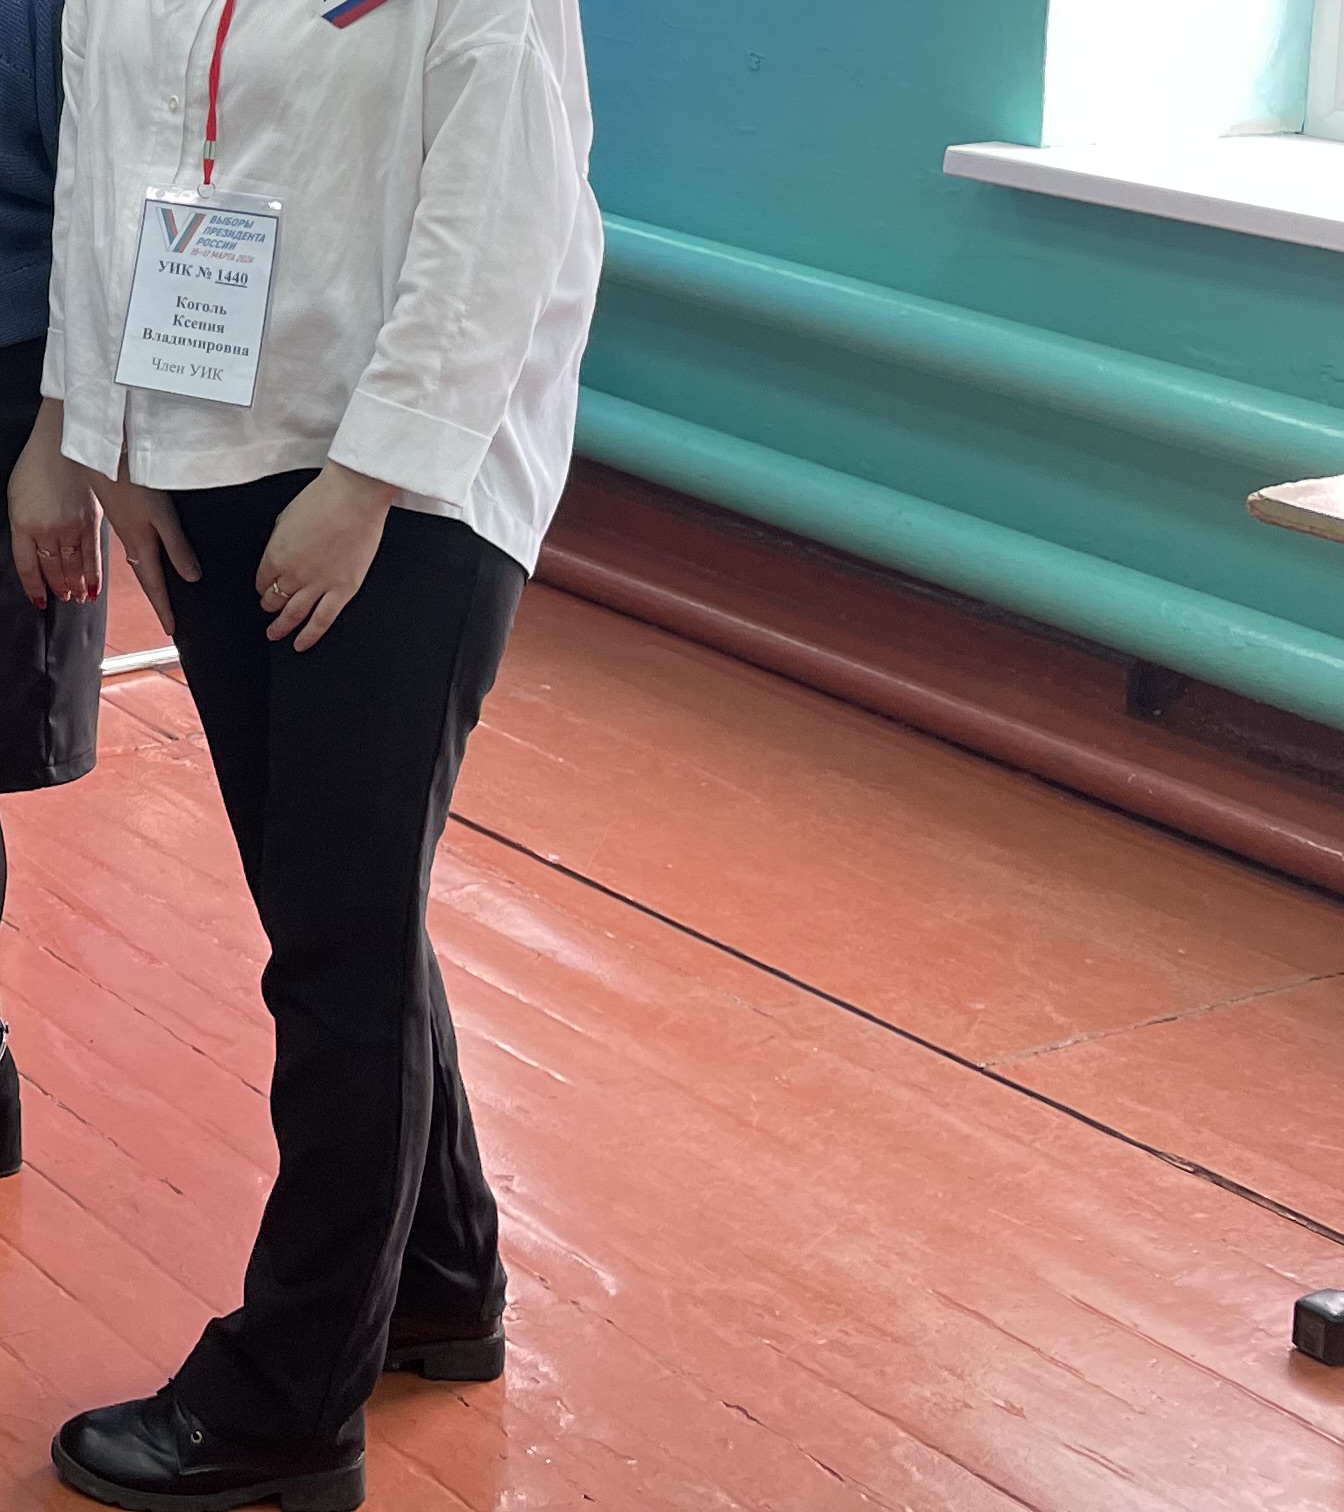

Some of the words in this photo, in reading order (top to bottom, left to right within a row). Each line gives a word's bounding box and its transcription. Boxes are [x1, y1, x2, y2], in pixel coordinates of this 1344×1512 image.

[209, 215, 255, 229] ВЫБОРЫ
[196, 237, 238, 251] РОССИИ
[202, 226, 266, 243] ПРЕЗИДЕНТА
[158, 260, 193, 277] УИК
[195, 266, 213, 280] №
[216, 269, 249, 285] 1440
[176, 295, 227, 316] Коголь
[172, 313, 225, 334] Ксения
[142, 327, 250, 357] Владимировна
[152, 356, 185, 375] Член
[190, 363, 224, 382] УИК
